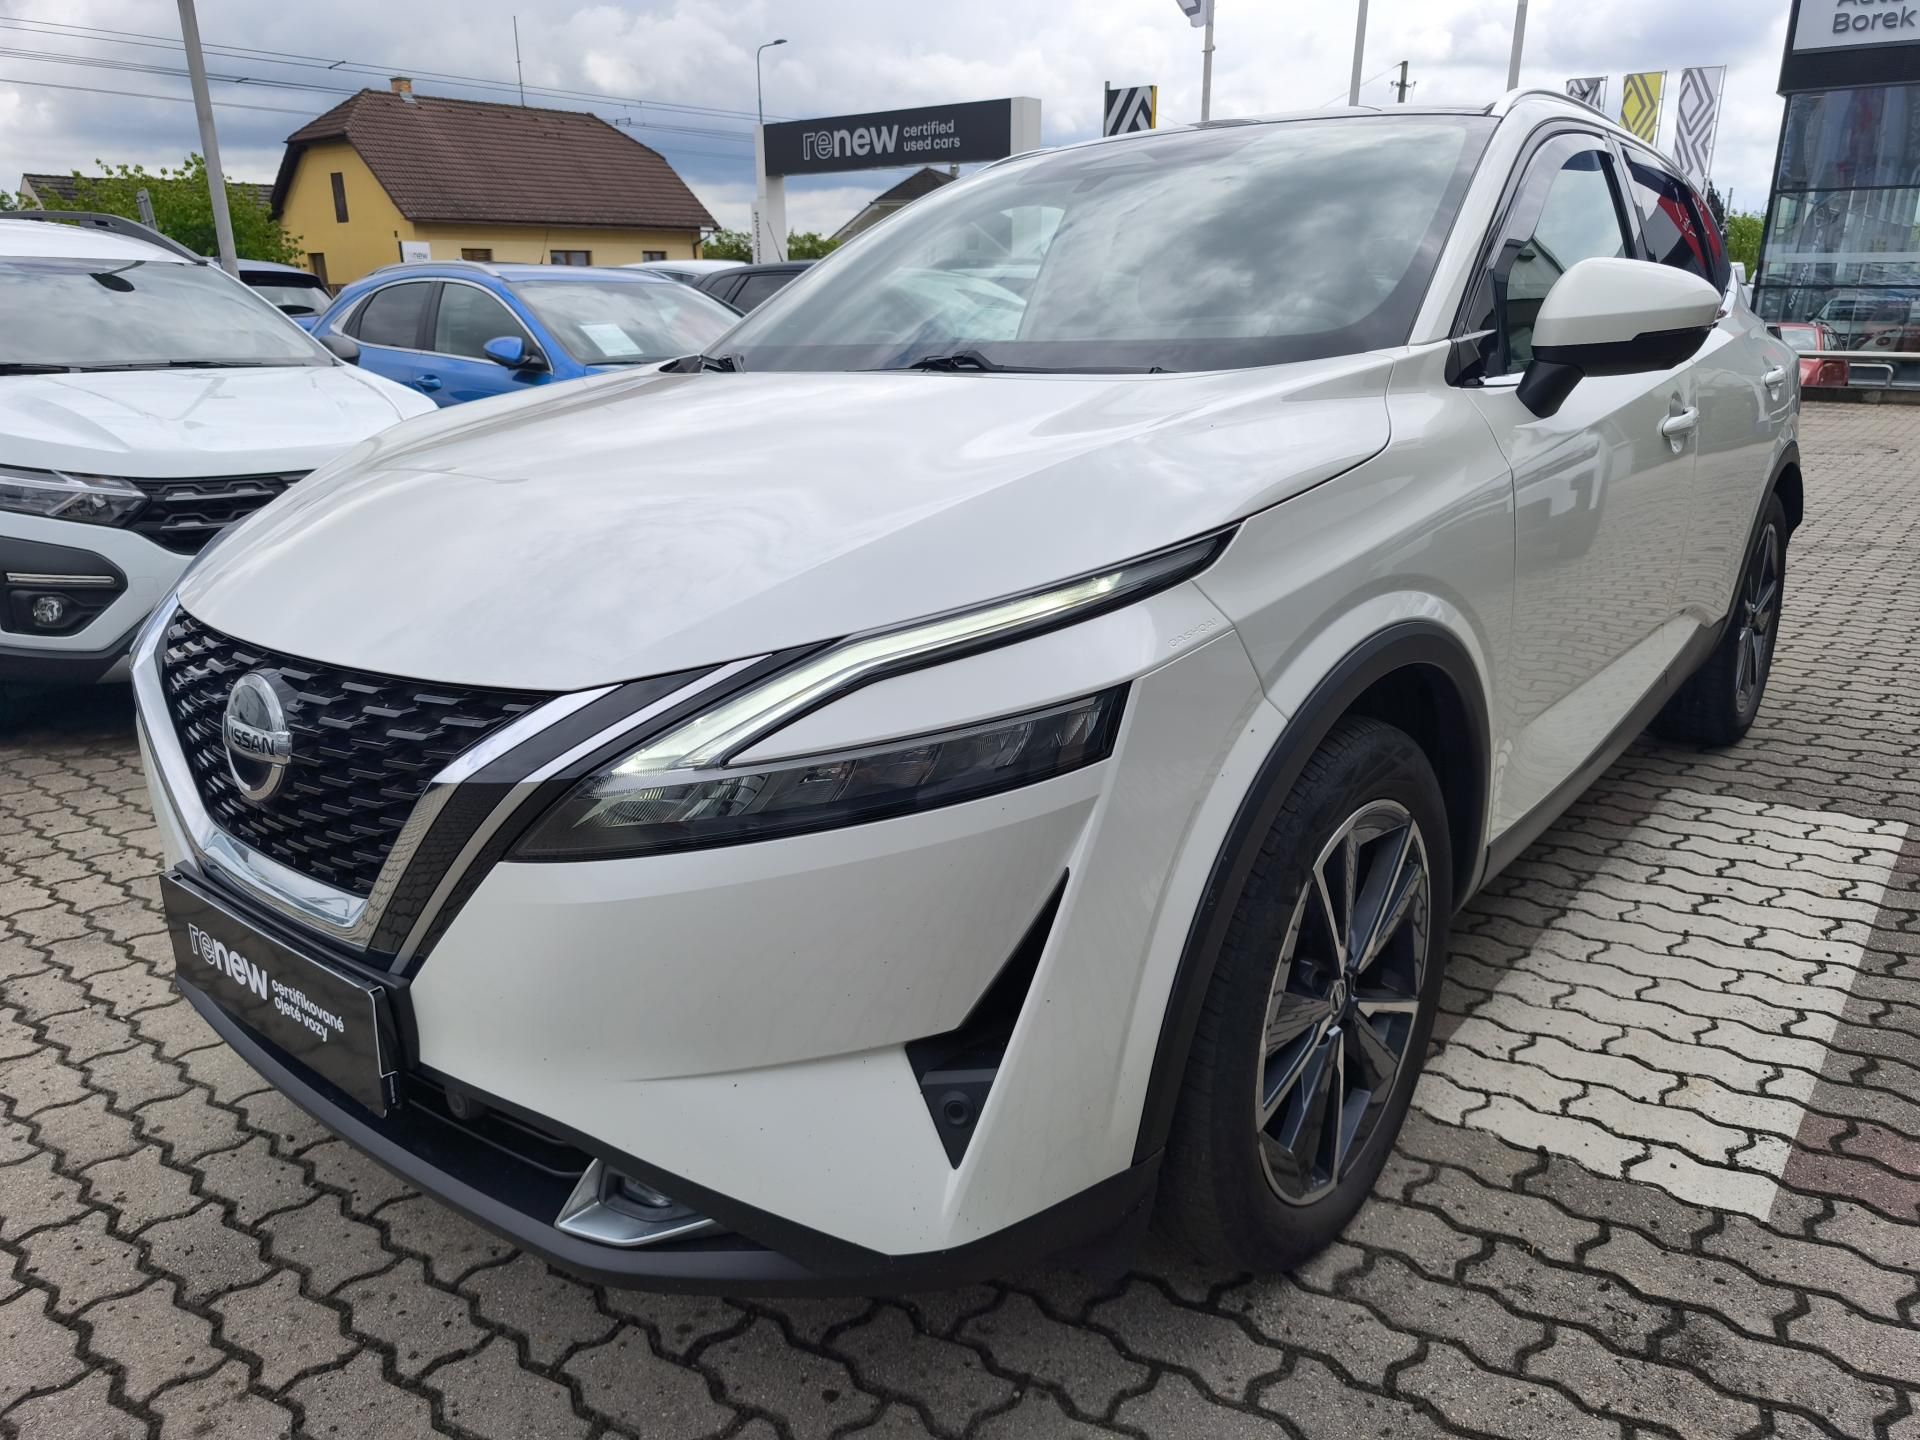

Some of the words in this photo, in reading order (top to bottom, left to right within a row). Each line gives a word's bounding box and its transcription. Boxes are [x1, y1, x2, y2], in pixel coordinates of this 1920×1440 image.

[1832, 6, 1917, 34] Borek
[803, 124, 899, 160] renew
[903, 119, 955, 138] certified
[903, 137, 931, 151] used
[934, 136, 961, 149] cars
[230, 725, 275, 756] ISSAN
[188, 923, 268, 1000] renew
[271, 979, 344, 1032] certifikované
[274, 997, 302, 1023] ojeté
[301, 1012, 328, 1042] vozy
